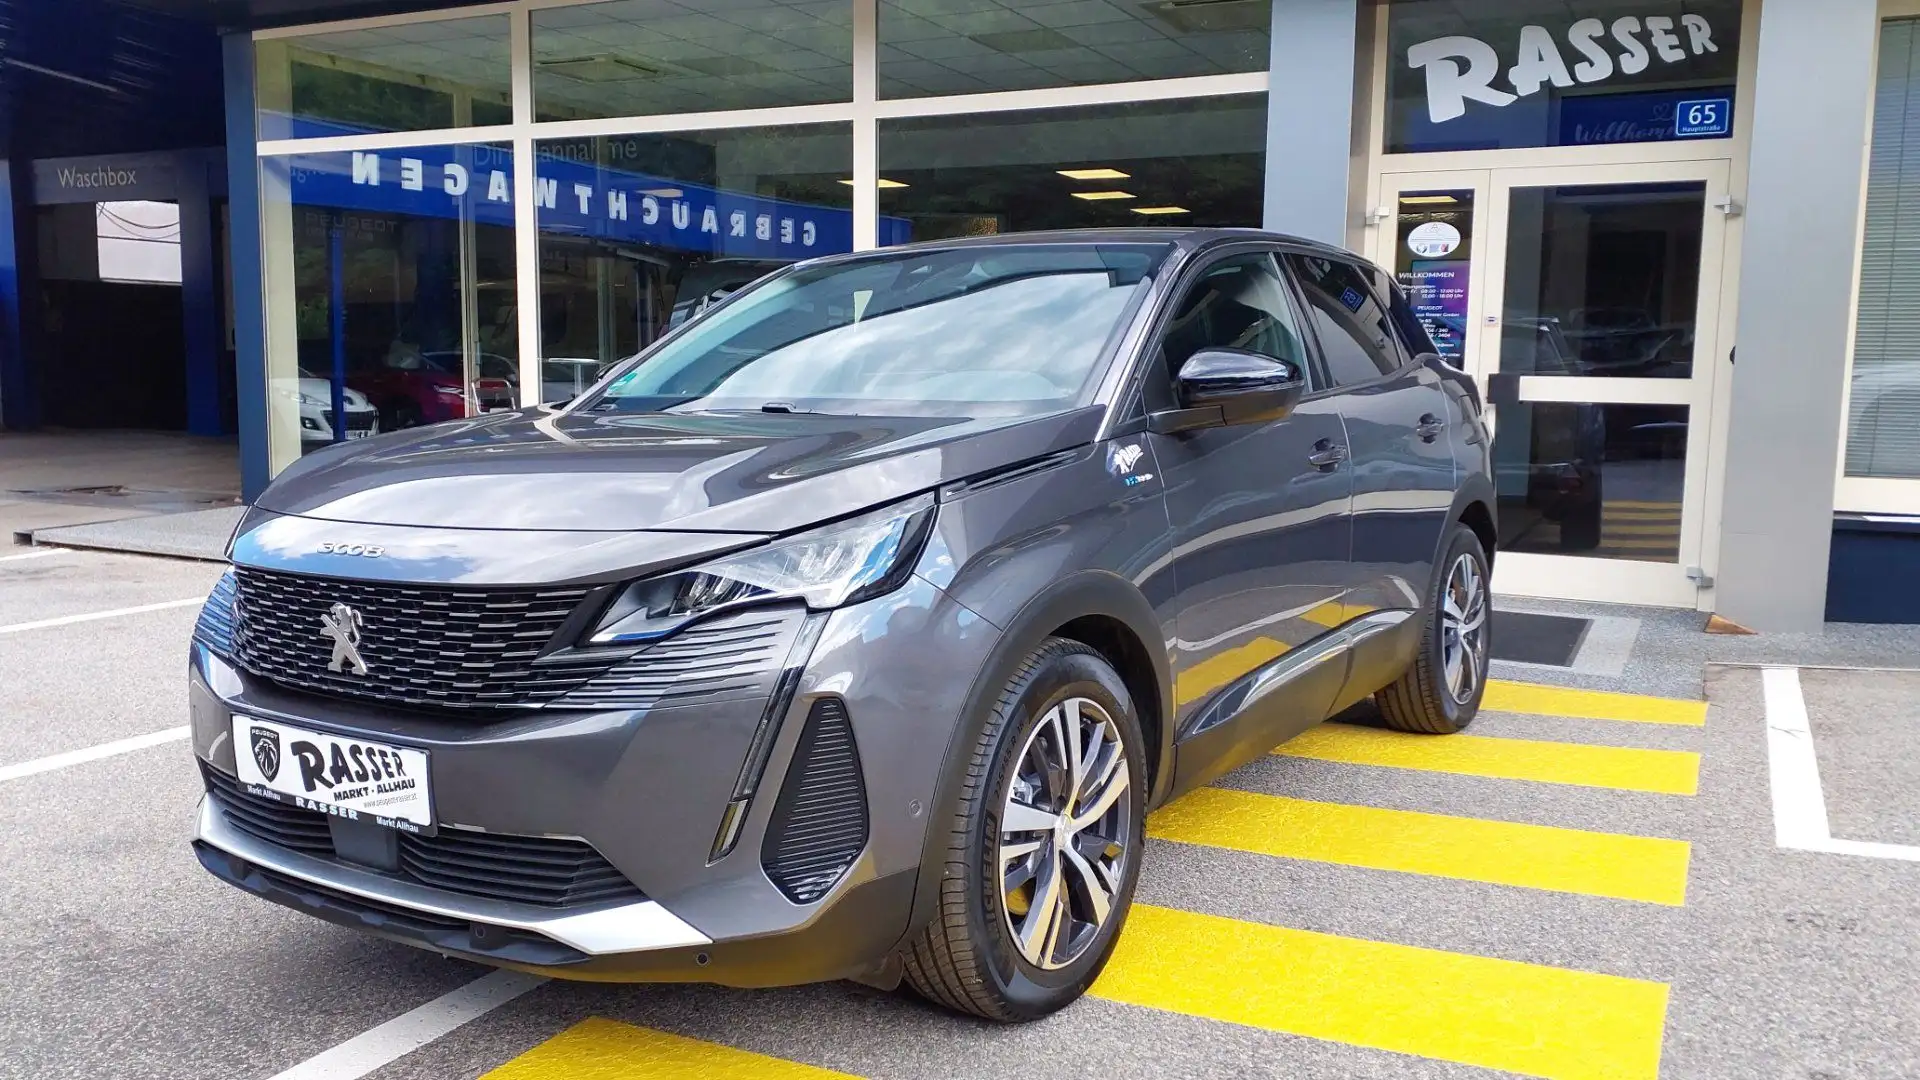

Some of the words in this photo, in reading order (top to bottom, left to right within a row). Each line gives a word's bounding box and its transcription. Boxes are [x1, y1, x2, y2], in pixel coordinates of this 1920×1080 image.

[1408, 13, 1718, 123] RASSER
[1688, 104, 1716, 125] 65
[56, 164, 137, 189] Waschbox
[1398, 271, 1455, 280] WILLKOMMEN
[316, 541, 385, 558] 3008
[251, 729, 278, 739] PEUGEOT
[290, 740, 407, 792] RASSER
[247, 784, 262, 794] Markt
[263, 789, 281, 800] Allhau
[333, 786, 369, 801] MARKT
[377, 779, 416, 794] ALLHAU
[295, 796, 359, 820] RASSER
[376, 815, 396, 828] Markt
[396, 820, 419, 833] Allhau
